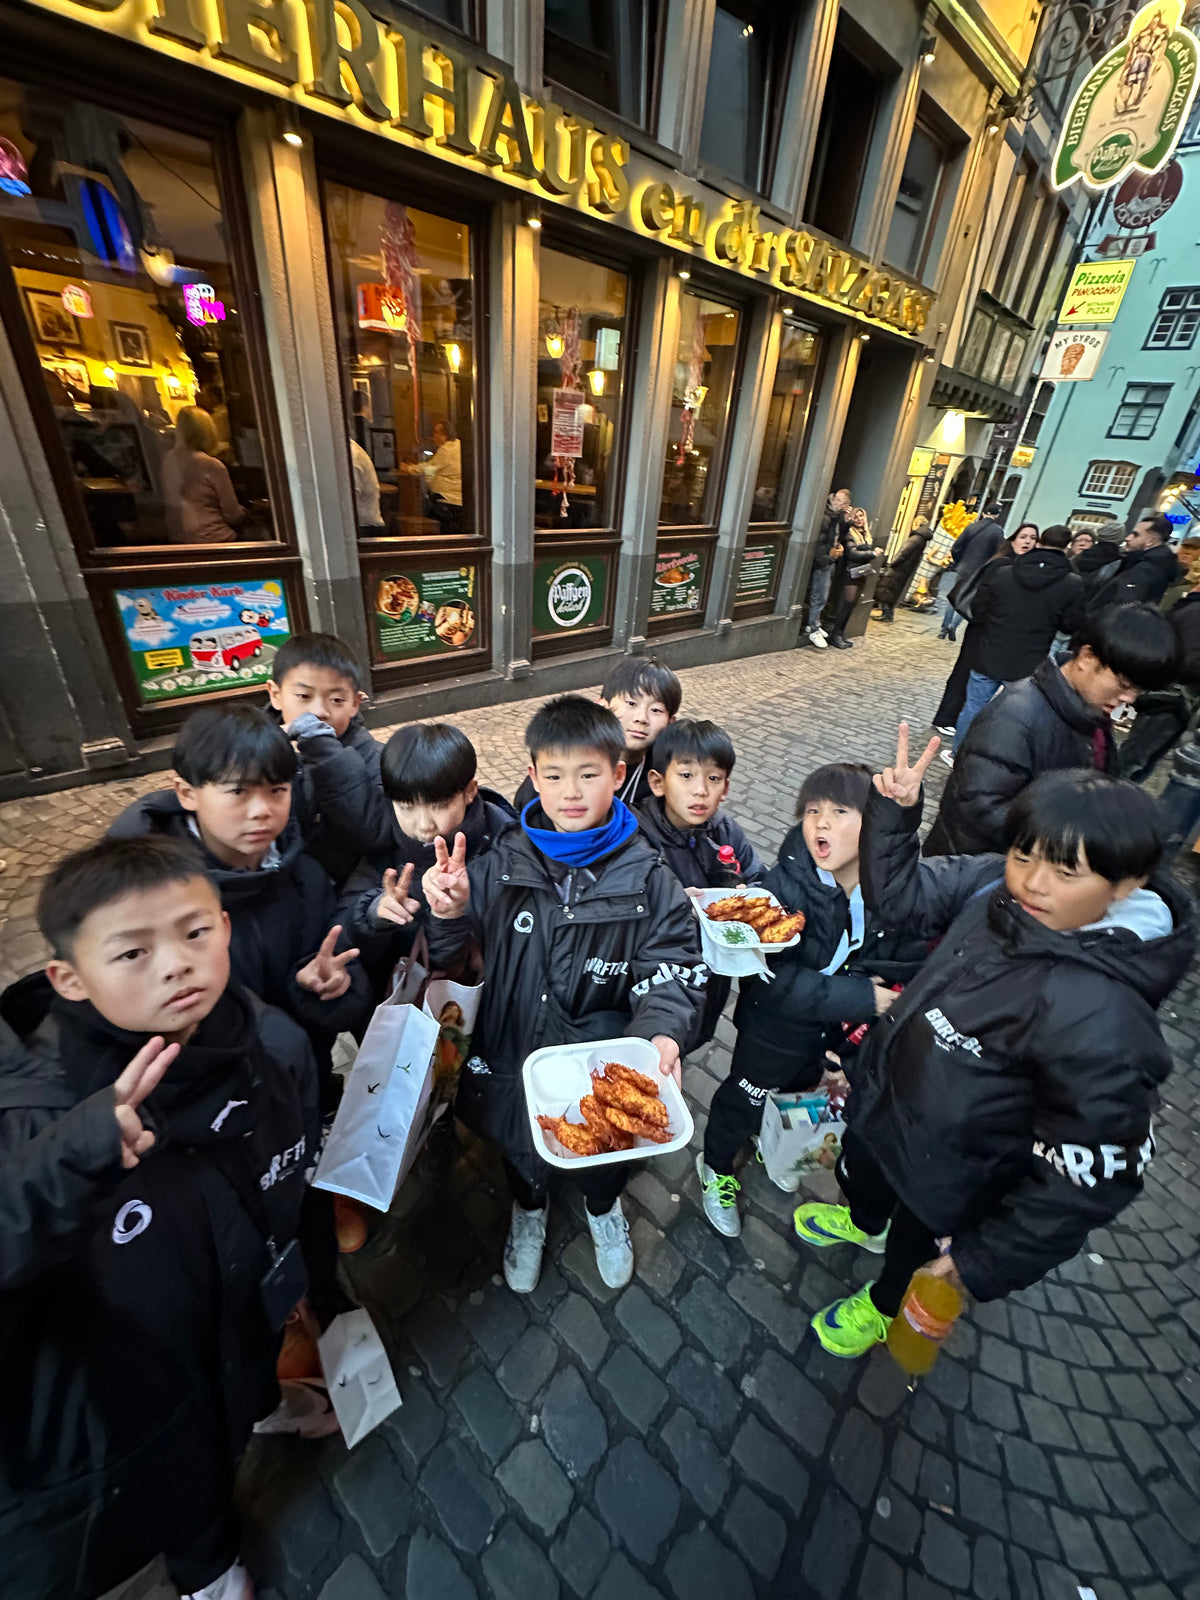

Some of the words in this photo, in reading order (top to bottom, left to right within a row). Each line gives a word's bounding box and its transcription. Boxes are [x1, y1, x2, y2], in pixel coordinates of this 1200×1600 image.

[1066, 56, 1126, 147] BIERHAUS
[1161, 62, 1196, 132] SALZGASS
[65, 0, 631, 214] ERHAUS
[641, 182, 707, 248] en
[1075, 270, 1126, 286] Pizzeria
[1071, 286, 1122, 297] PINOCCHIO
[1055, 337, 1069, 349] MY
[1072, 335, 1101, 348] GYROS
